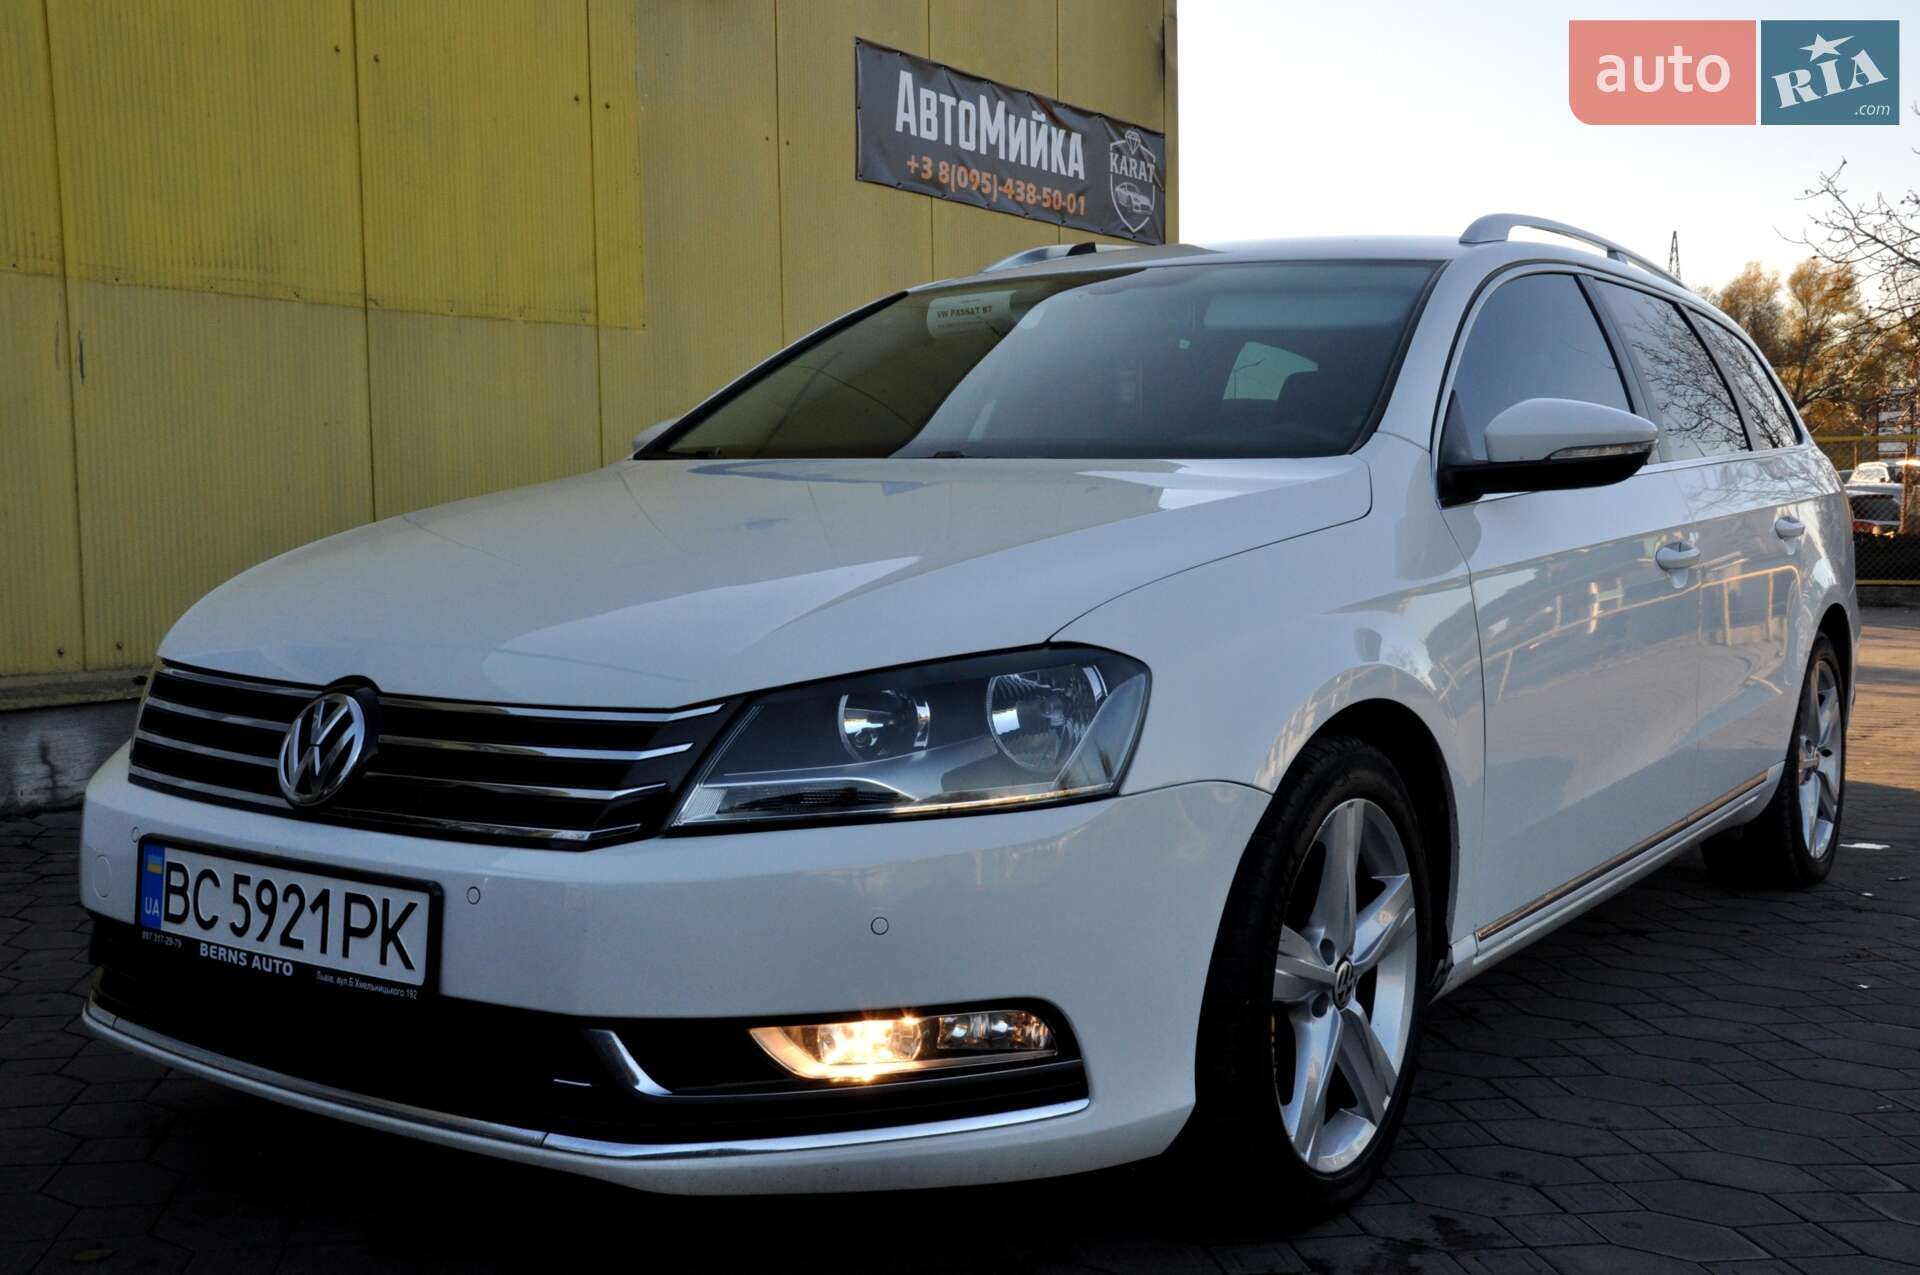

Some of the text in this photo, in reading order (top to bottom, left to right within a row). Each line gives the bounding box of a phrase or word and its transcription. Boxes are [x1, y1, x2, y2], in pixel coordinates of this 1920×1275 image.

[1109, 150, 1157, 184] KARAT
[144, 896, 160, 917] UA
[164, 861, 418, 970] BC 5921 PK
[200, 943, 293, 976] BERNS AUTO
